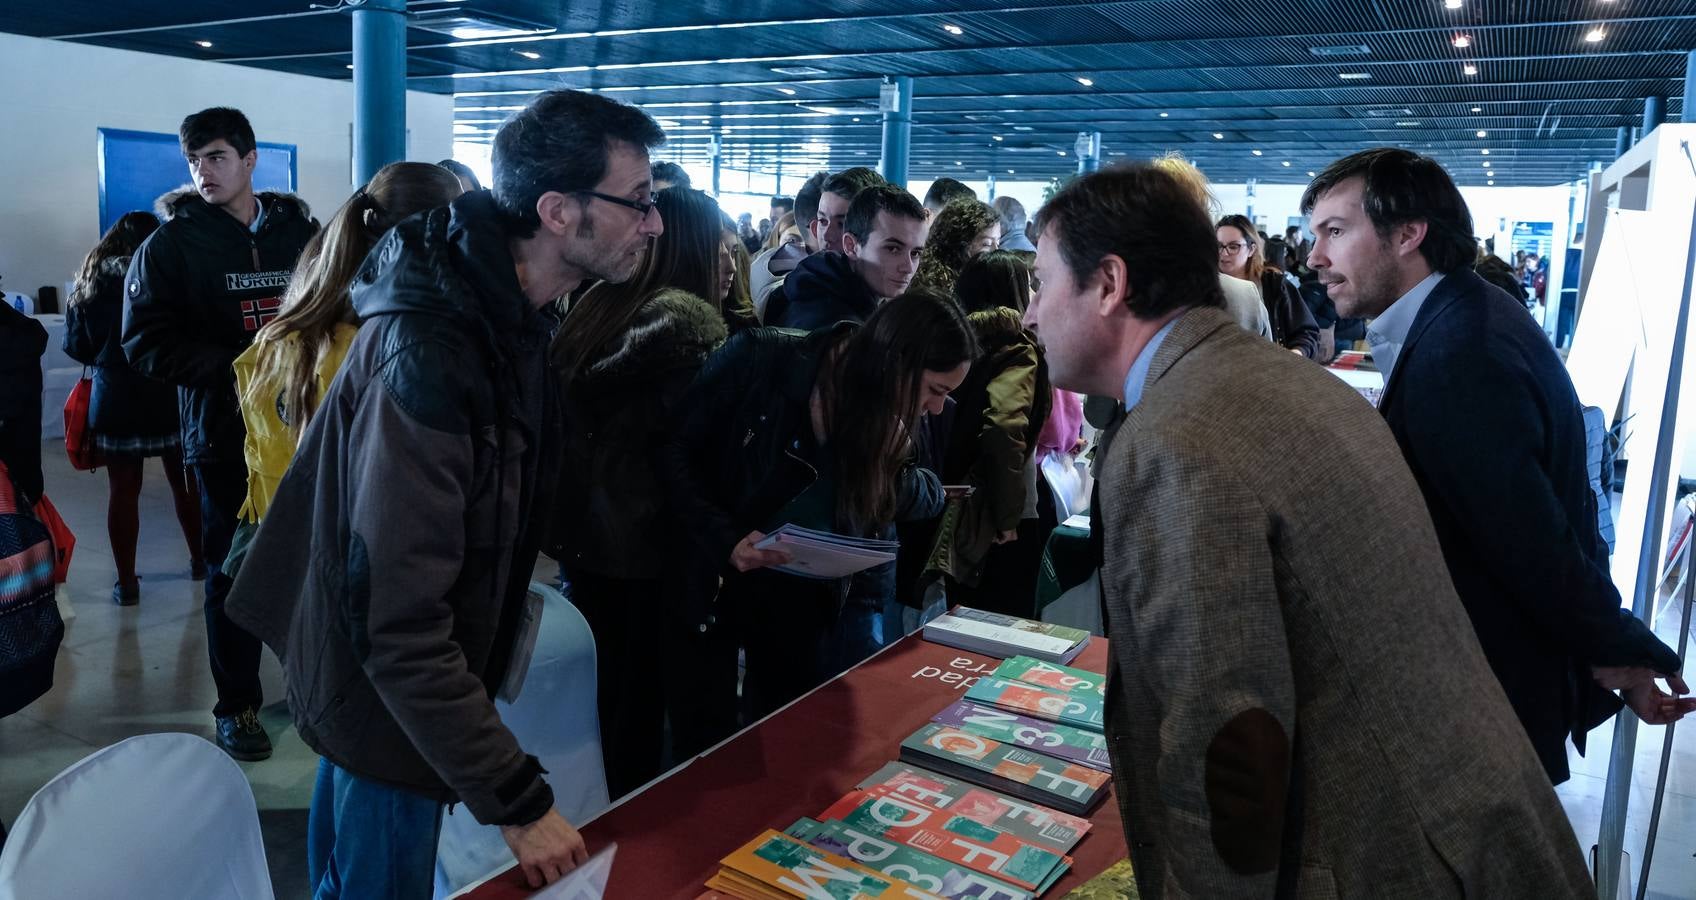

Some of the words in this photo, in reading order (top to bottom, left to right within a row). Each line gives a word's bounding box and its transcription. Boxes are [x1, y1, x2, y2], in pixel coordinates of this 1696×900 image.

[1035, 768, 1090, 798] F
[997, 797, 1050, 827] F
[951, 838, 1010, 873] F
